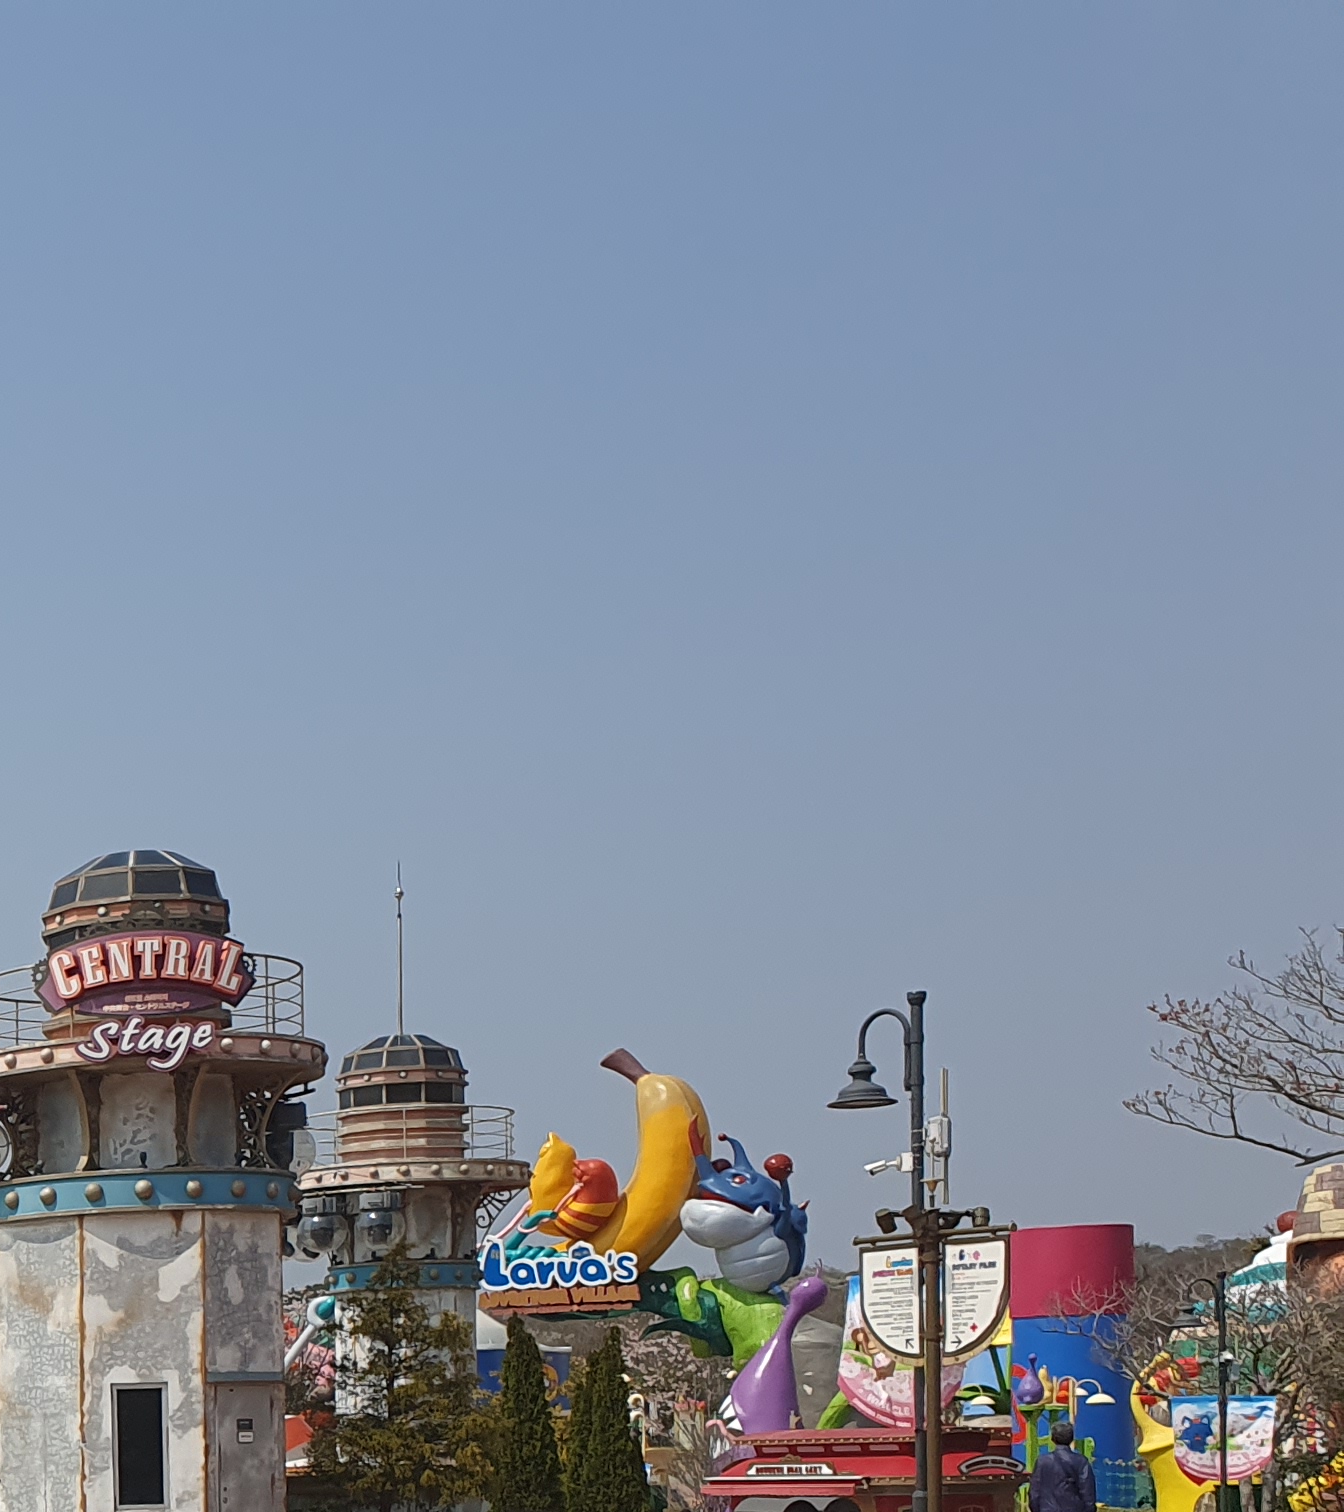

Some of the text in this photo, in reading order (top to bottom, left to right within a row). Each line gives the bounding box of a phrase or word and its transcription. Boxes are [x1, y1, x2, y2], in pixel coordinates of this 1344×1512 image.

[49, 936, 245, 999] CENTRAL
[78, 1017, 213, 1070] Stage
[482, 1238, 637, 1288] Larva's
